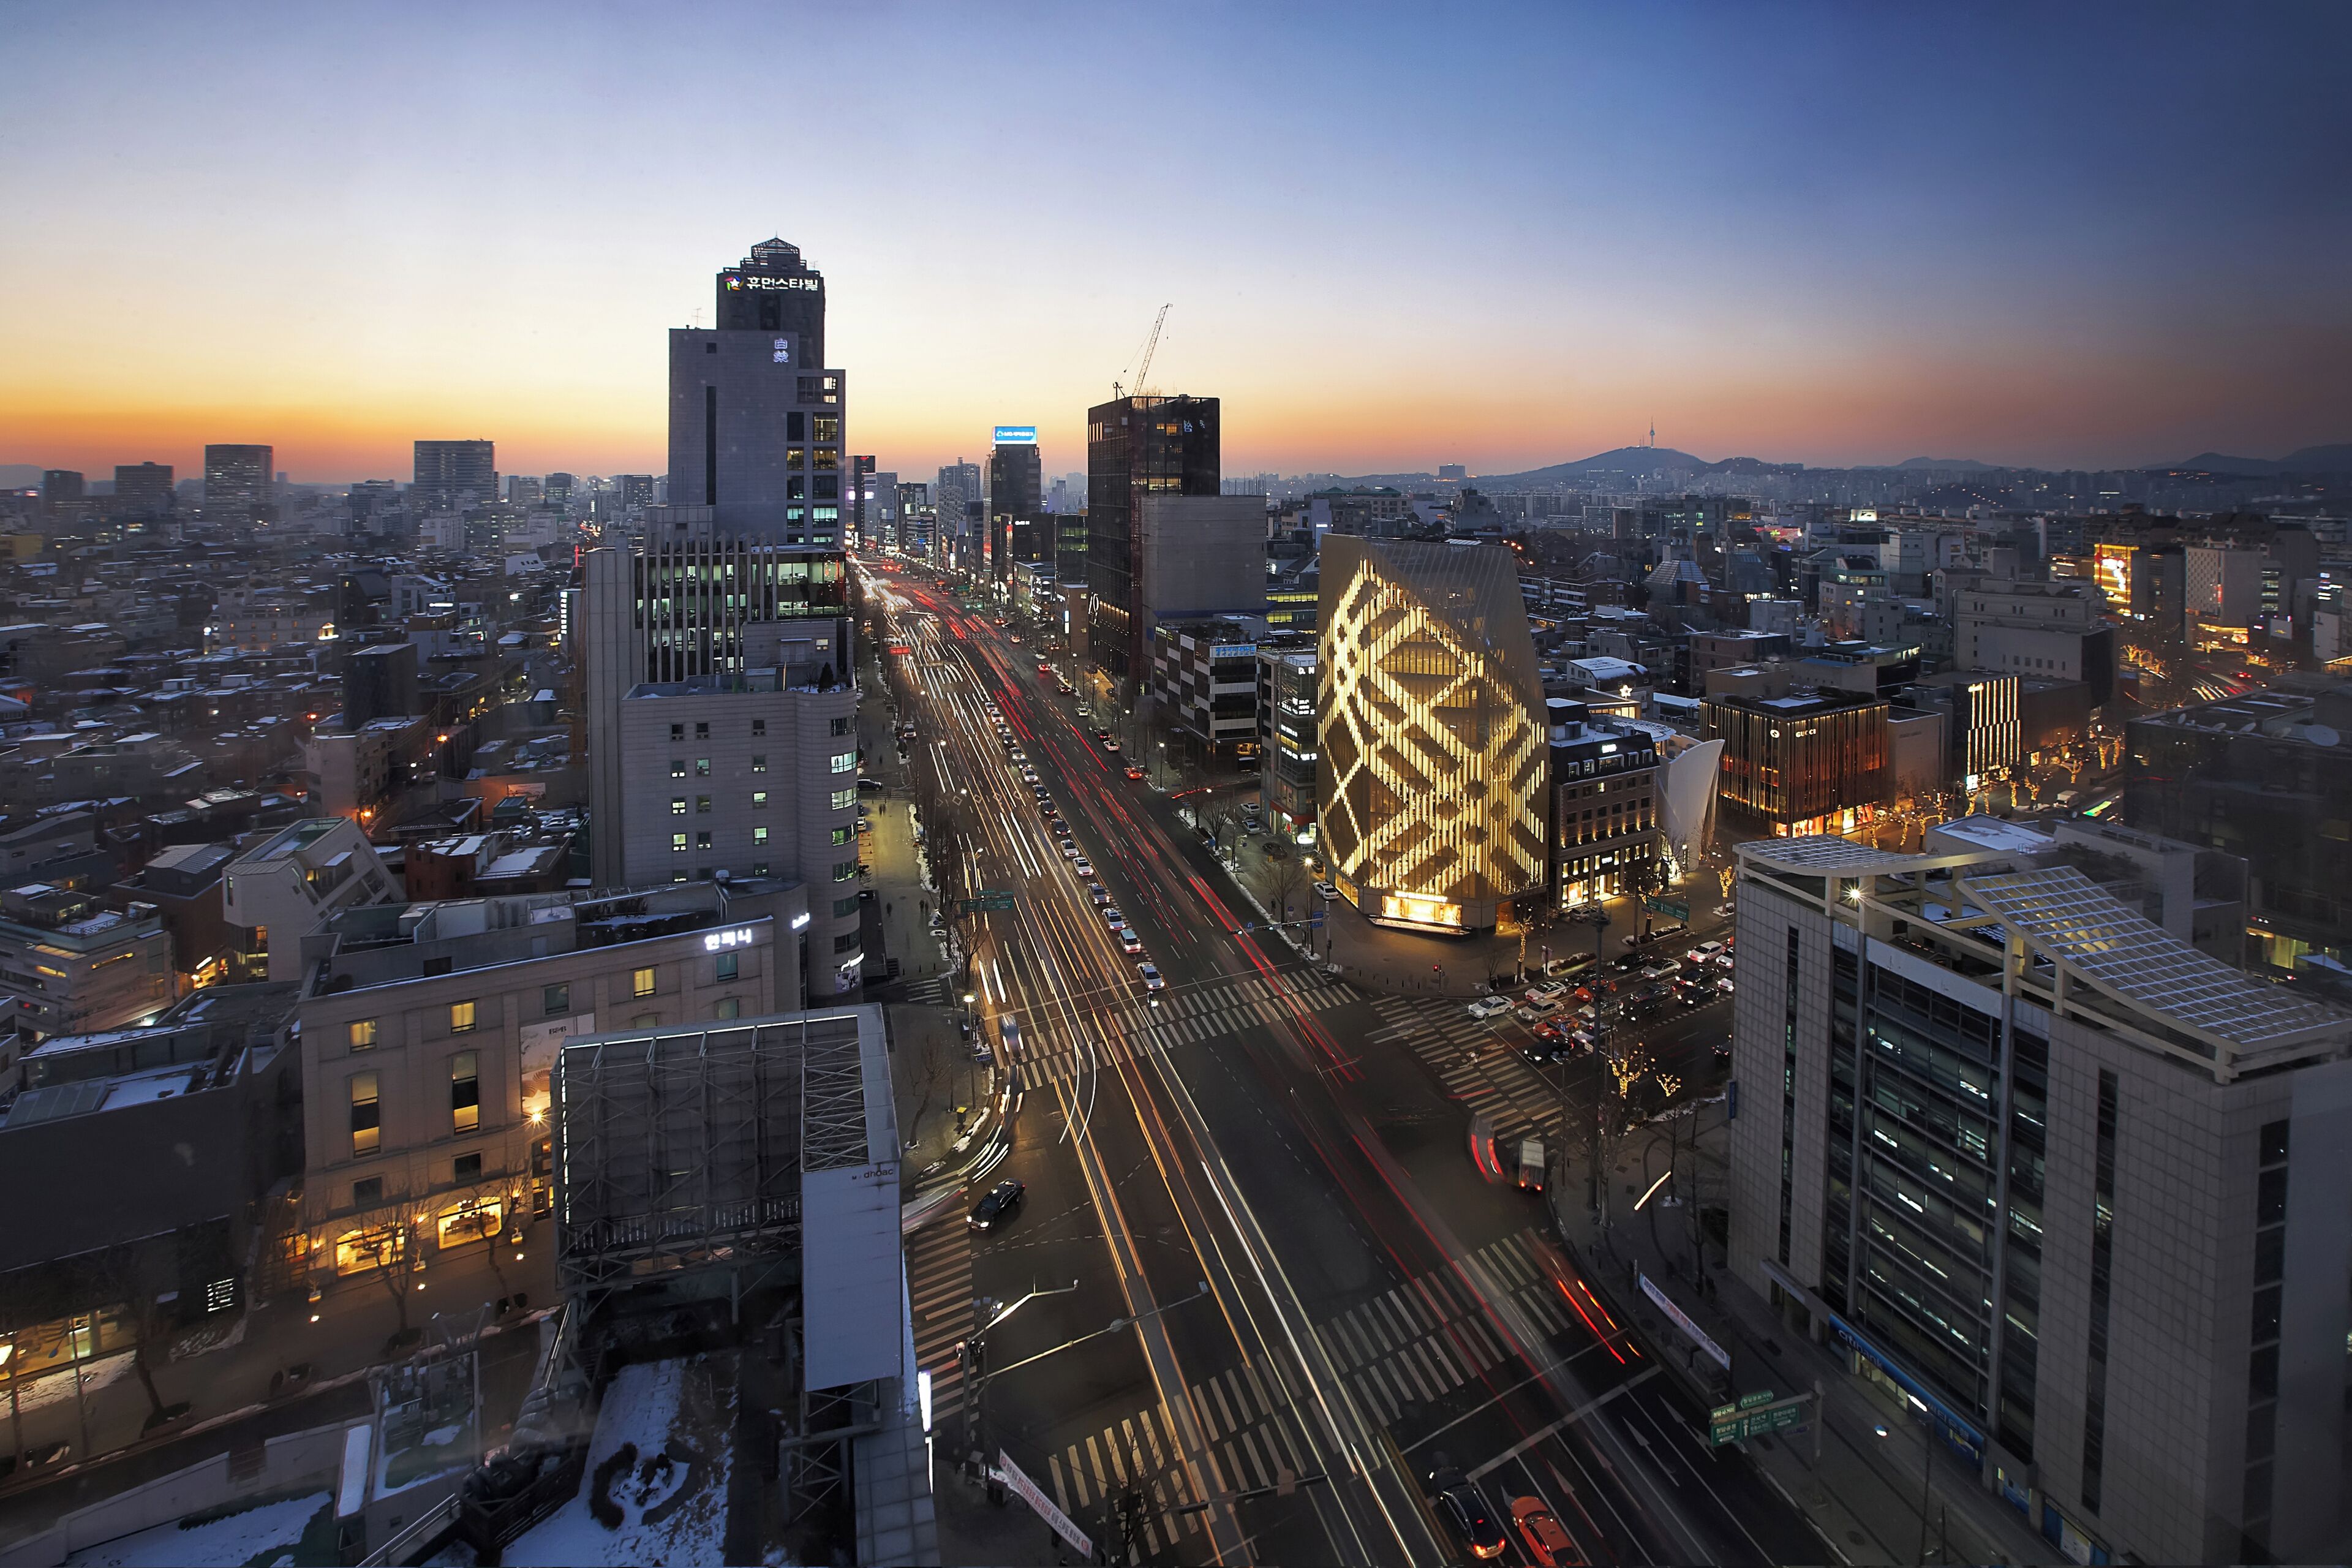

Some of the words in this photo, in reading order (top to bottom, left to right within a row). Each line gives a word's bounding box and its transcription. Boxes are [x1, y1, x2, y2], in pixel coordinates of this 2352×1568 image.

[747, 277, 818, 291] 휴먼스타빌
[1796, 729, 1816, 737] GUCCI
[1839, 1330, 1882, 1370] citibank
